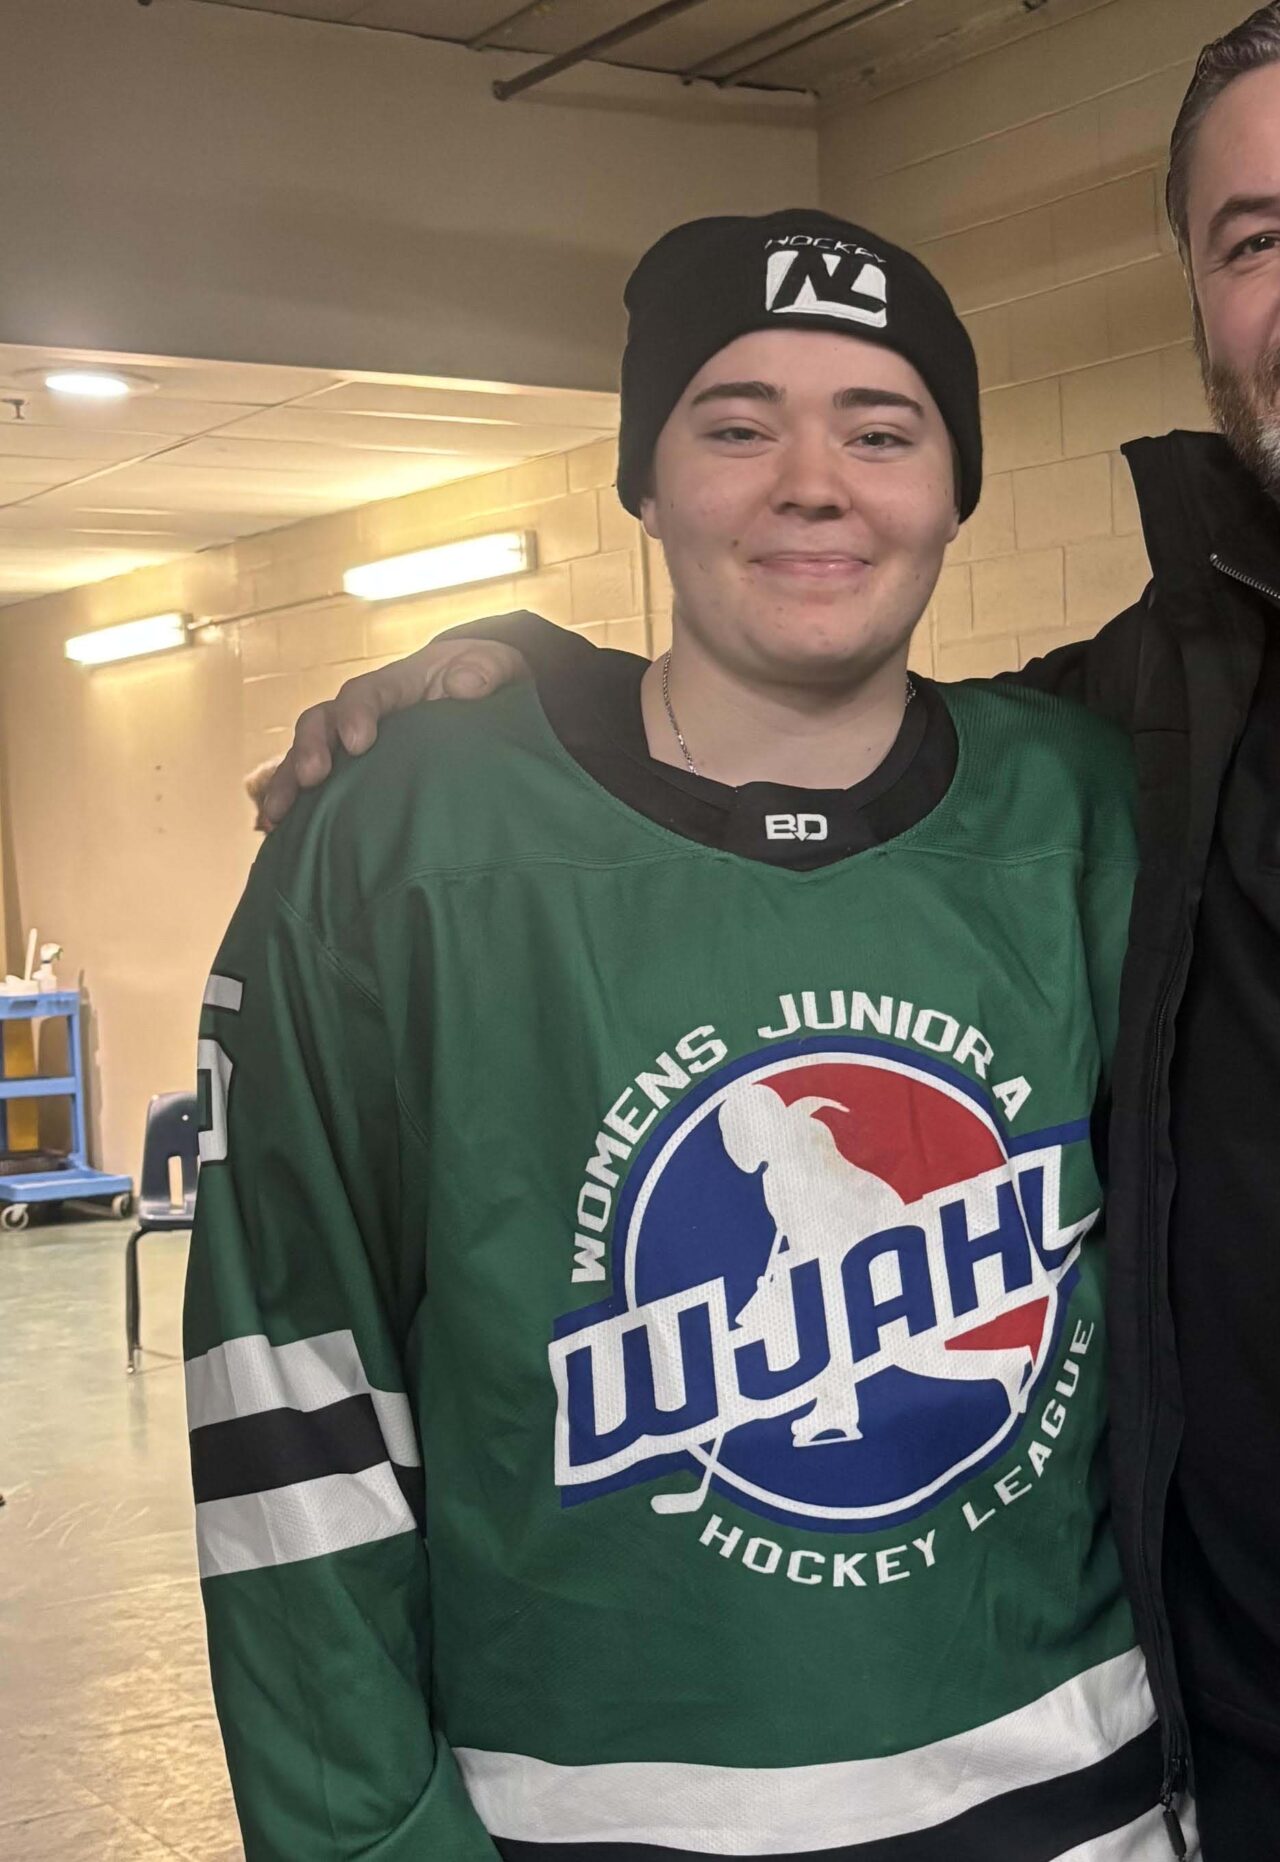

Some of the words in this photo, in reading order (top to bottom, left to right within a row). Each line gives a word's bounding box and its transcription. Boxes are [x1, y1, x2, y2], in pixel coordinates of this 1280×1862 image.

[764, 235, 887, 263] HOCKEY
[570, 1025, 728, 1284] WOMENS
[757, 990, 995, 1078] JUNIOR
[992, 1075, 1032, 1122] A
[548, 1145, 1100, 1486] WJAHL
[699, 1514, 938, 1587] HOCKEY
[963, 1319, 1095, 1532] LEAGUE
